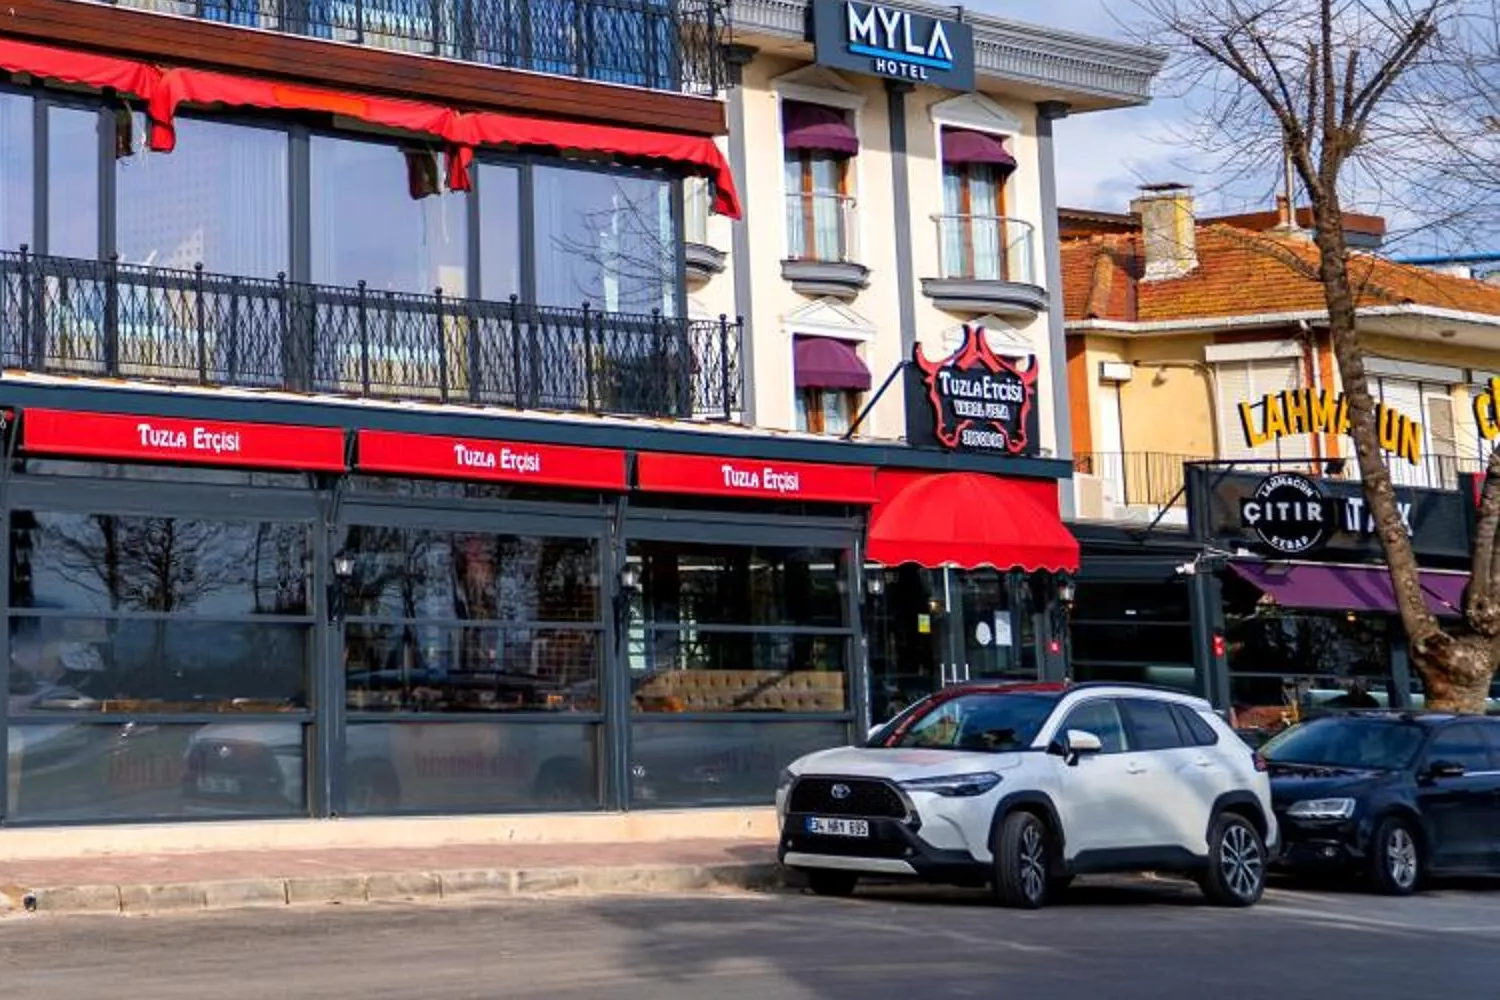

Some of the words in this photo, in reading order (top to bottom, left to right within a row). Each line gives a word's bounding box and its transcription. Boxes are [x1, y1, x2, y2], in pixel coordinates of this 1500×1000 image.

[847, 0, 953, 61] MYLA
[875, 58, 929, 79] HOTEL
[136, 423, 187, 448] TUZLA
[1238, 386, 1422, 466] LAHMAUN
[454, 444, 496, 468] TUZLA
[721, 464, 760, 488] TUZLA
[1243, 500, 1324, 525] ÇITIR
